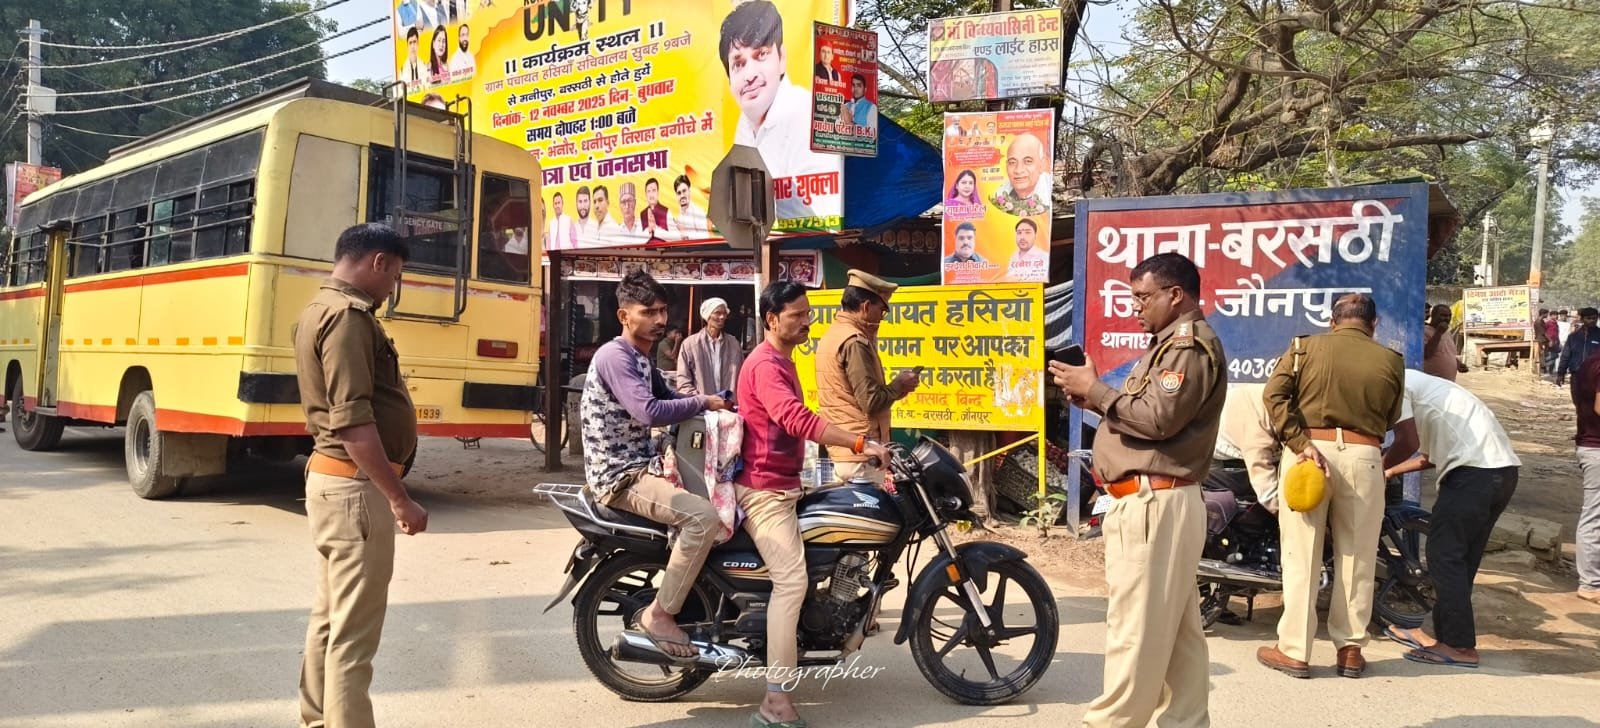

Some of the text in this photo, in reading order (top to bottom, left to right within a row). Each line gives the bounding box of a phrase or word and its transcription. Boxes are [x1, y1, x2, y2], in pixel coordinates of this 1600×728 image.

[522, 41, 590, 71] कार्यक्रम
[596, 28, 641, 52] स्थल
[995, 37, 1025, 55] लाईट
[485, 80, 504, 92] ग्राम
[507, 71, 539, 87] पंचायत
[577, 50, 628, 71] सचिवालय
[631, 42, 658, 62] सुबह
[508, 94, 516, 106] से
[596, 73, 606, 87] से
[610, 69, 629, 84] होते
[529, 109, 539, 122] 12
[542, 101, 575, 118] नवम्बर
[578, 95, 605, 111] 2025
[637, 79, 674, 103] बुधवार
[526, 107, 636, 142] समय दोपहर 1:00 बजे
[582, 131, 617, 154] धनीपुर
[622, 126, 655, 146] तिराहा
[660, 115, 697, 138] बगीचे
[701, 111, 713, 131] में
[568, 156, 592, 181] एवं
[597, 150, 668, 178] जनसभा
[796, 171, 839, 206] शुक्ला
[1214, 274, 1373, 327] जौनपु
[933, 336, 960, 358] पर
[936, 366, 984, 389] करता
